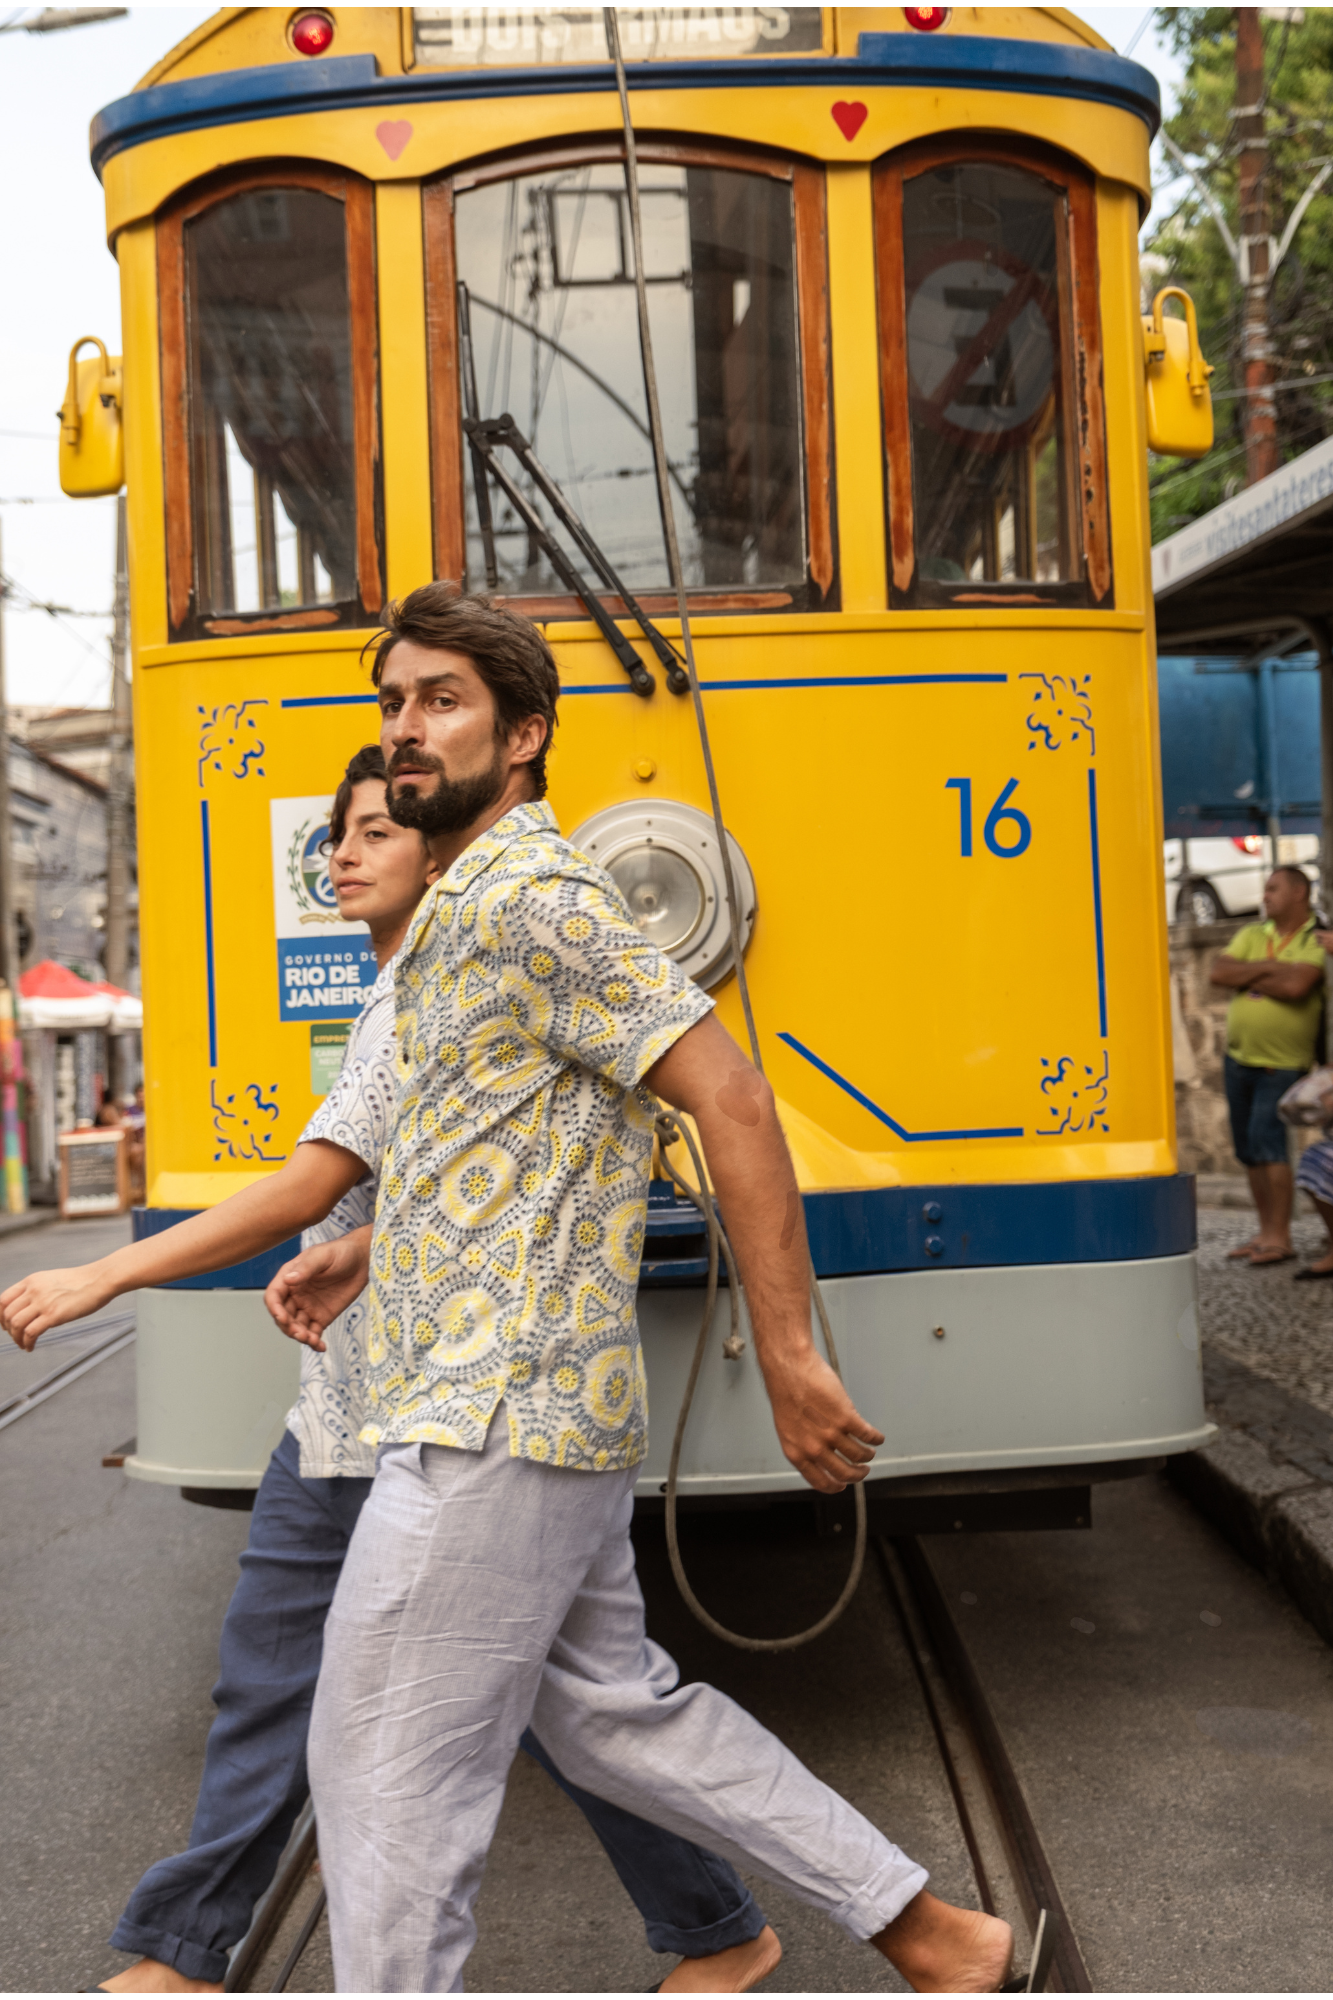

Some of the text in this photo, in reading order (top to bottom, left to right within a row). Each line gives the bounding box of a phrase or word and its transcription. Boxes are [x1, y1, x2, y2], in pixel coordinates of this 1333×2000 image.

[451, 7, 571, 51] DOIS
[945, 777, 1032, 859] 16
[285, 952, 353, 966] GOVERNO
[285, 965, 360, 987] RIO DE
